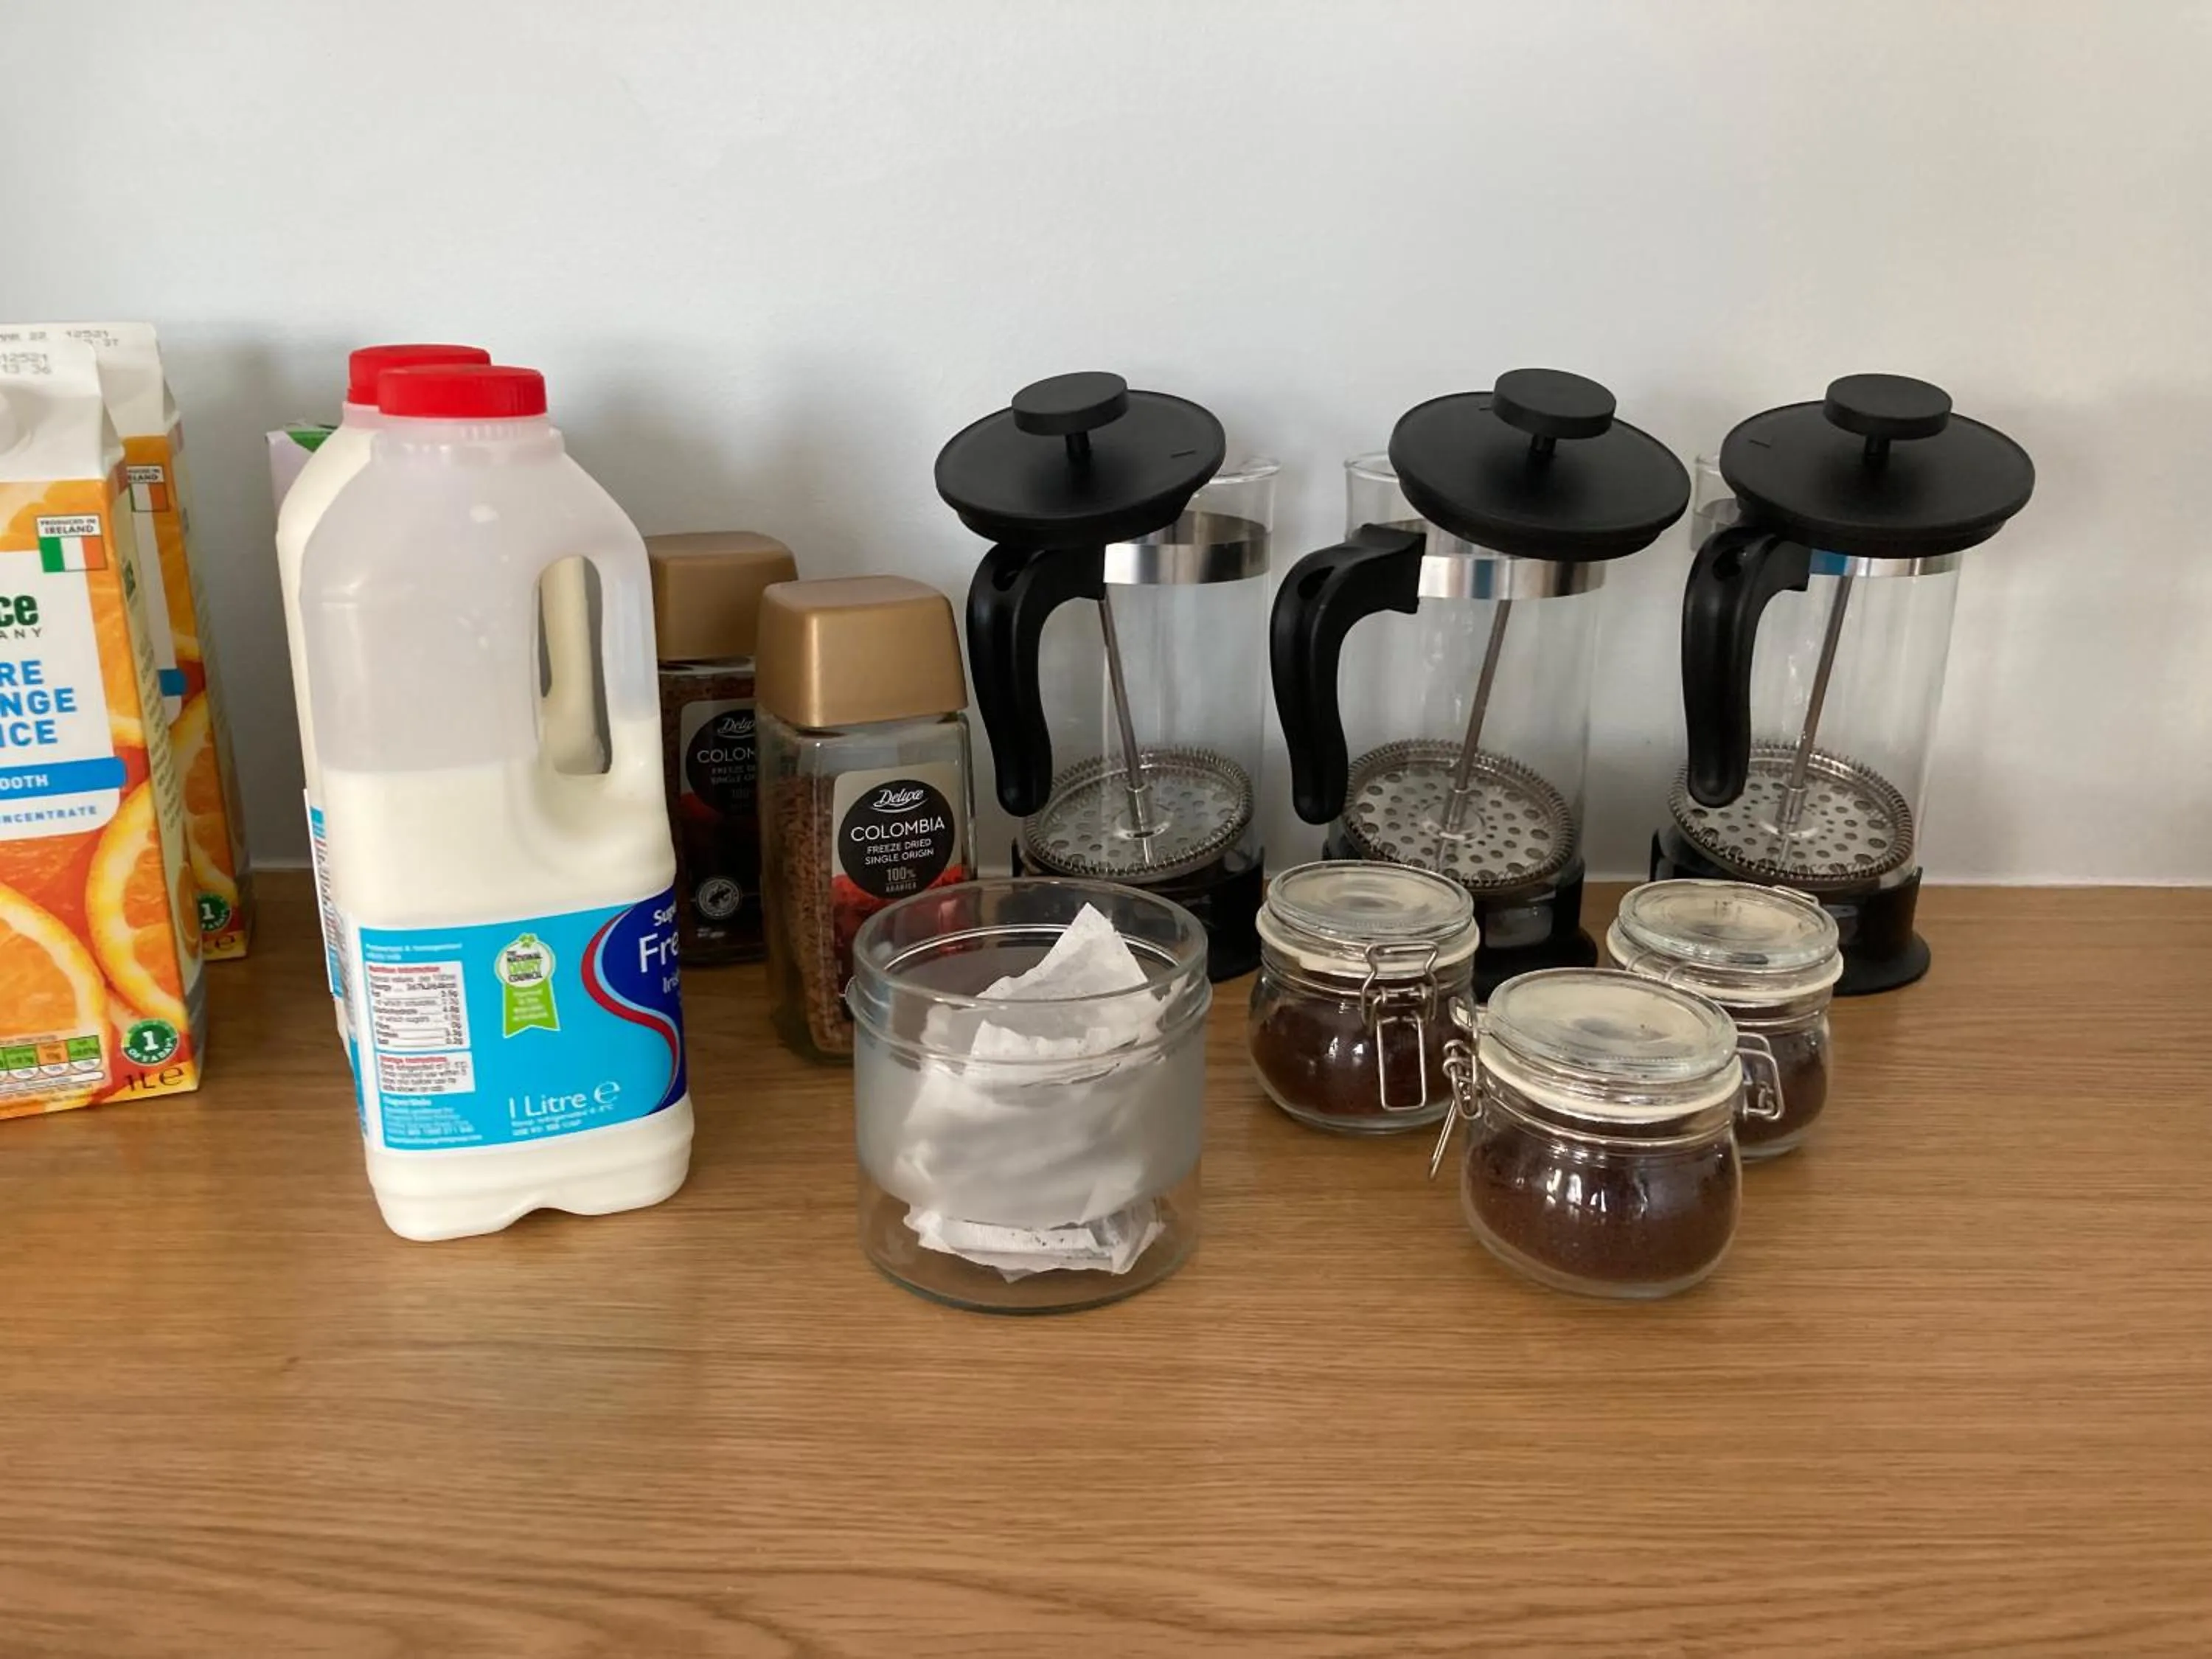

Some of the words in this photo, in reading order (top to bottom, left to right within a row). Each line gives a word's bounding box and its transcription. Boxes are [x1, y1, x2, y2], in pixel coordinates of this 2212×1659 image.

[44, 525, 94, 535] IRELAND
[0, 660, 44, 686] RE
[0, 687, 77, 717] NGE
[873, 788, 925, 808] Deluxe
[850, 815, 945, 842] COLOMBIA
[864, 852, 900, 866] SINGLE
[902, 847, 934, 861] ORIGIN
[866, 842, 902, 855] FREEZE
[904, 838, 932, 851] DRIED
[201, 902, 215, 920] 1
[142, 1030, 159, 1052] 1
[524, 1093, 588, 1117] Litre
